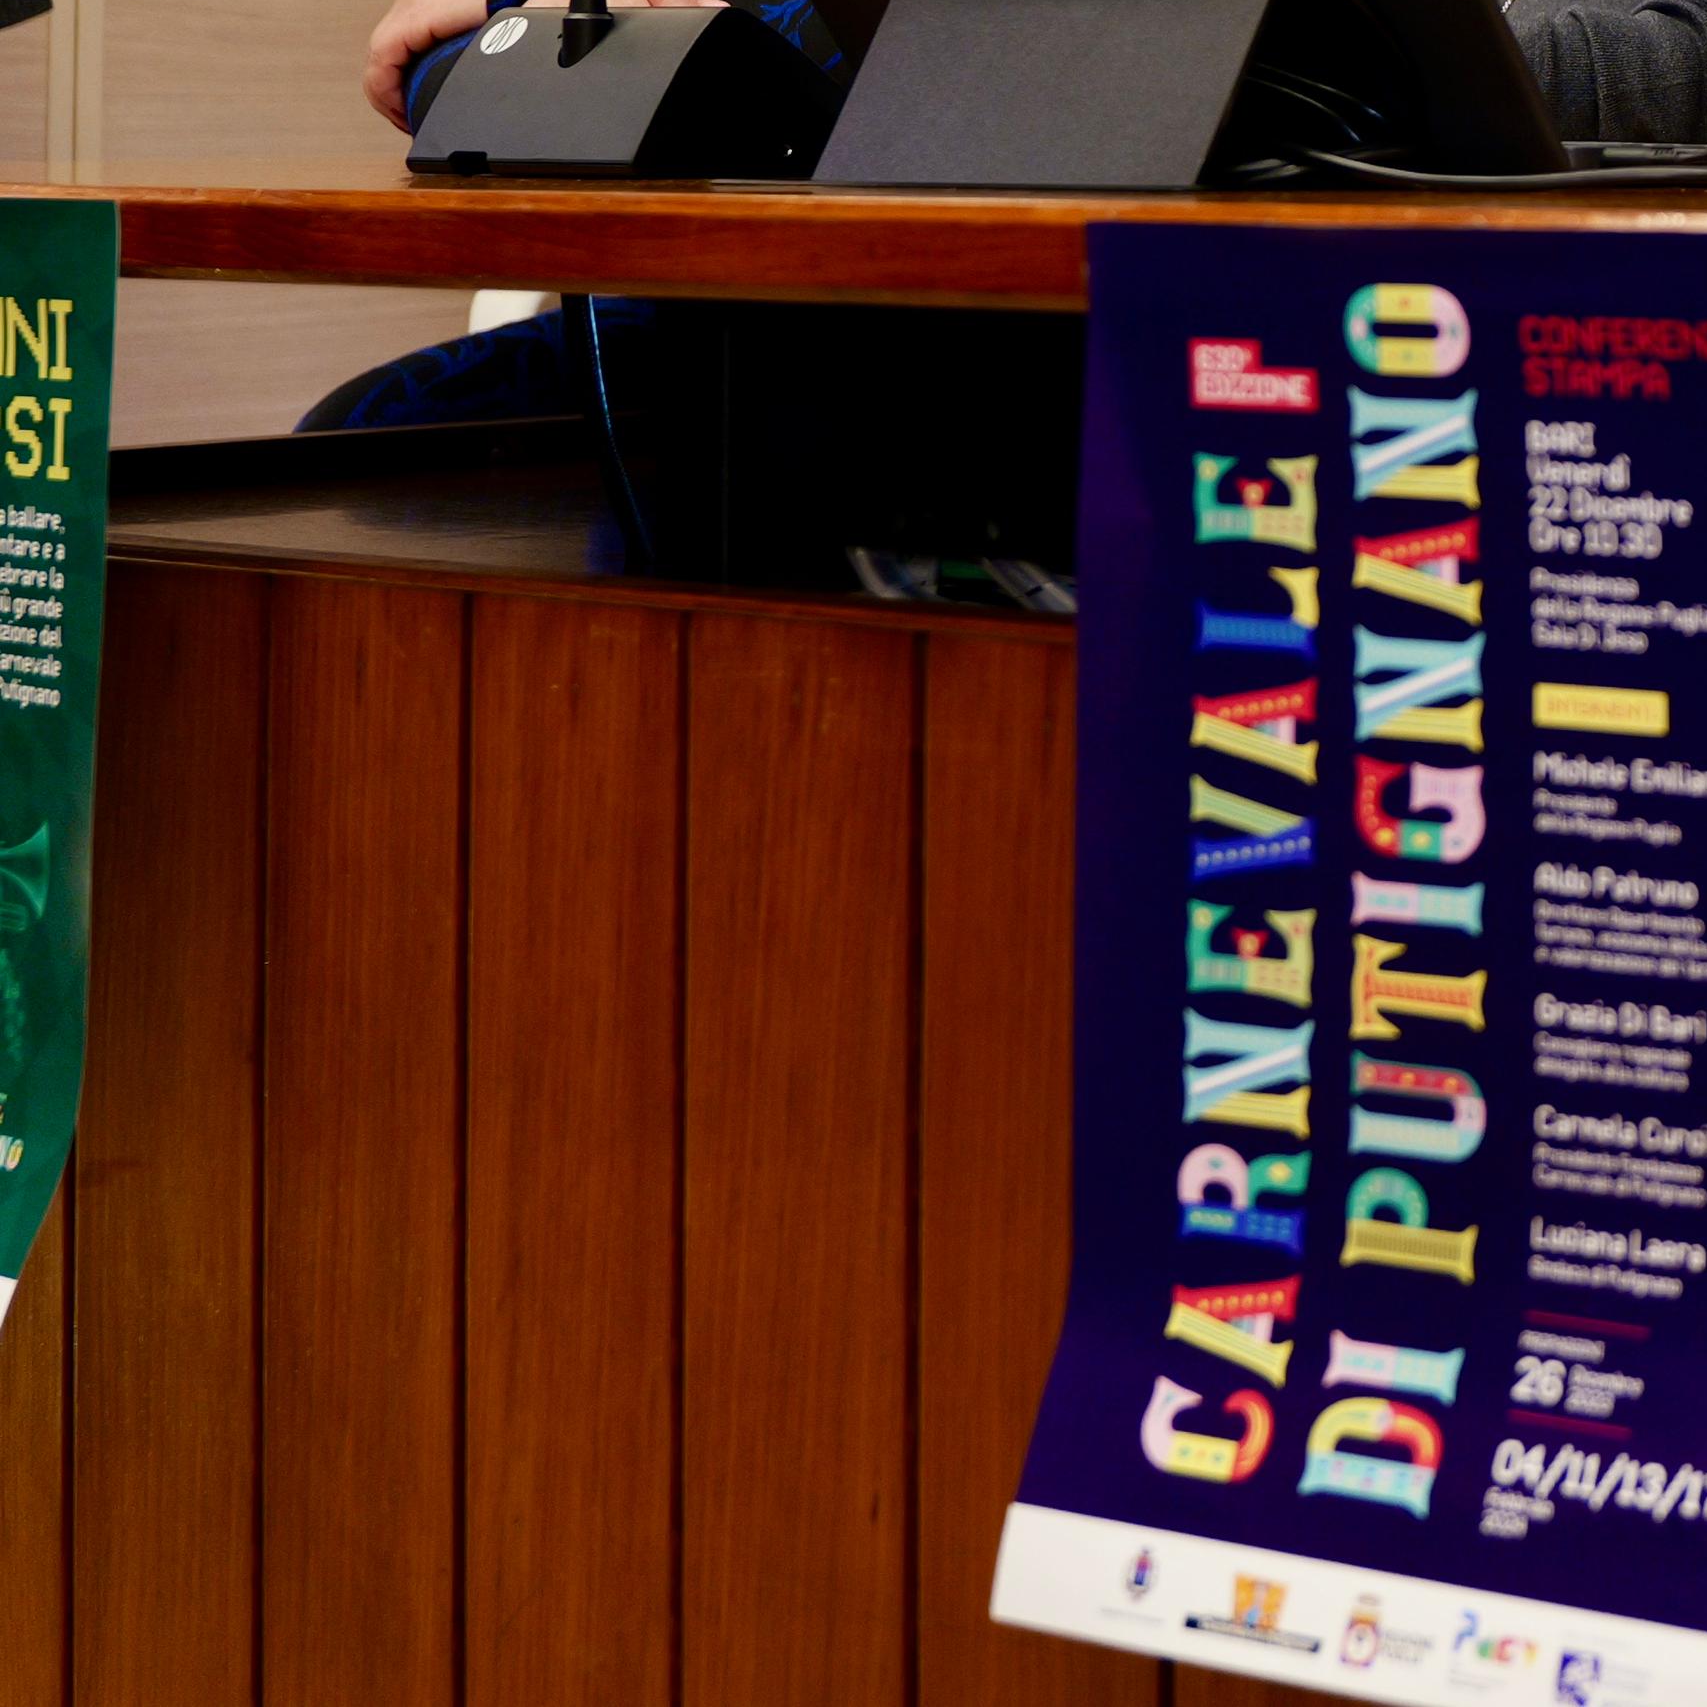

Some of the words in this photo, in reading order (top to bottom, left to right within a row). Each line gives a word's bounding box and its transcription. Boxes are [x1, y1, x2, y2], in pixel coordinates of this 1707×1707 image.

[0, 296, 73, 381] NI
[1522, 355, 1671, 400] STAMPA
[1525, 419, 1597, 458] BARI
[1528, 484, 1568, 522] 22
[42, 542, 53, 560] e
[55, 543, 66, 562] a
[49, 565, 65, 591] la
[12, 595, 64, 621] grande
[38, 624, 63, 648] del
[1339, 281, 1489, 1285] PUTIGNANO
[1533, 750, 1629, 791] Michele
[1533, 861, 1592, 899] Aldo
[1592, 866, 1699, 909] Patruno
[1140, 452, 1320, 1484] CARNEVALE
[1533, 992, 1617, 1035] Grazia
[1530, 1214, 1628, 1262] Luciana
[1509, 1355, 1567, 1408] 26
[1297, 1328, 1466, 1520] DI
